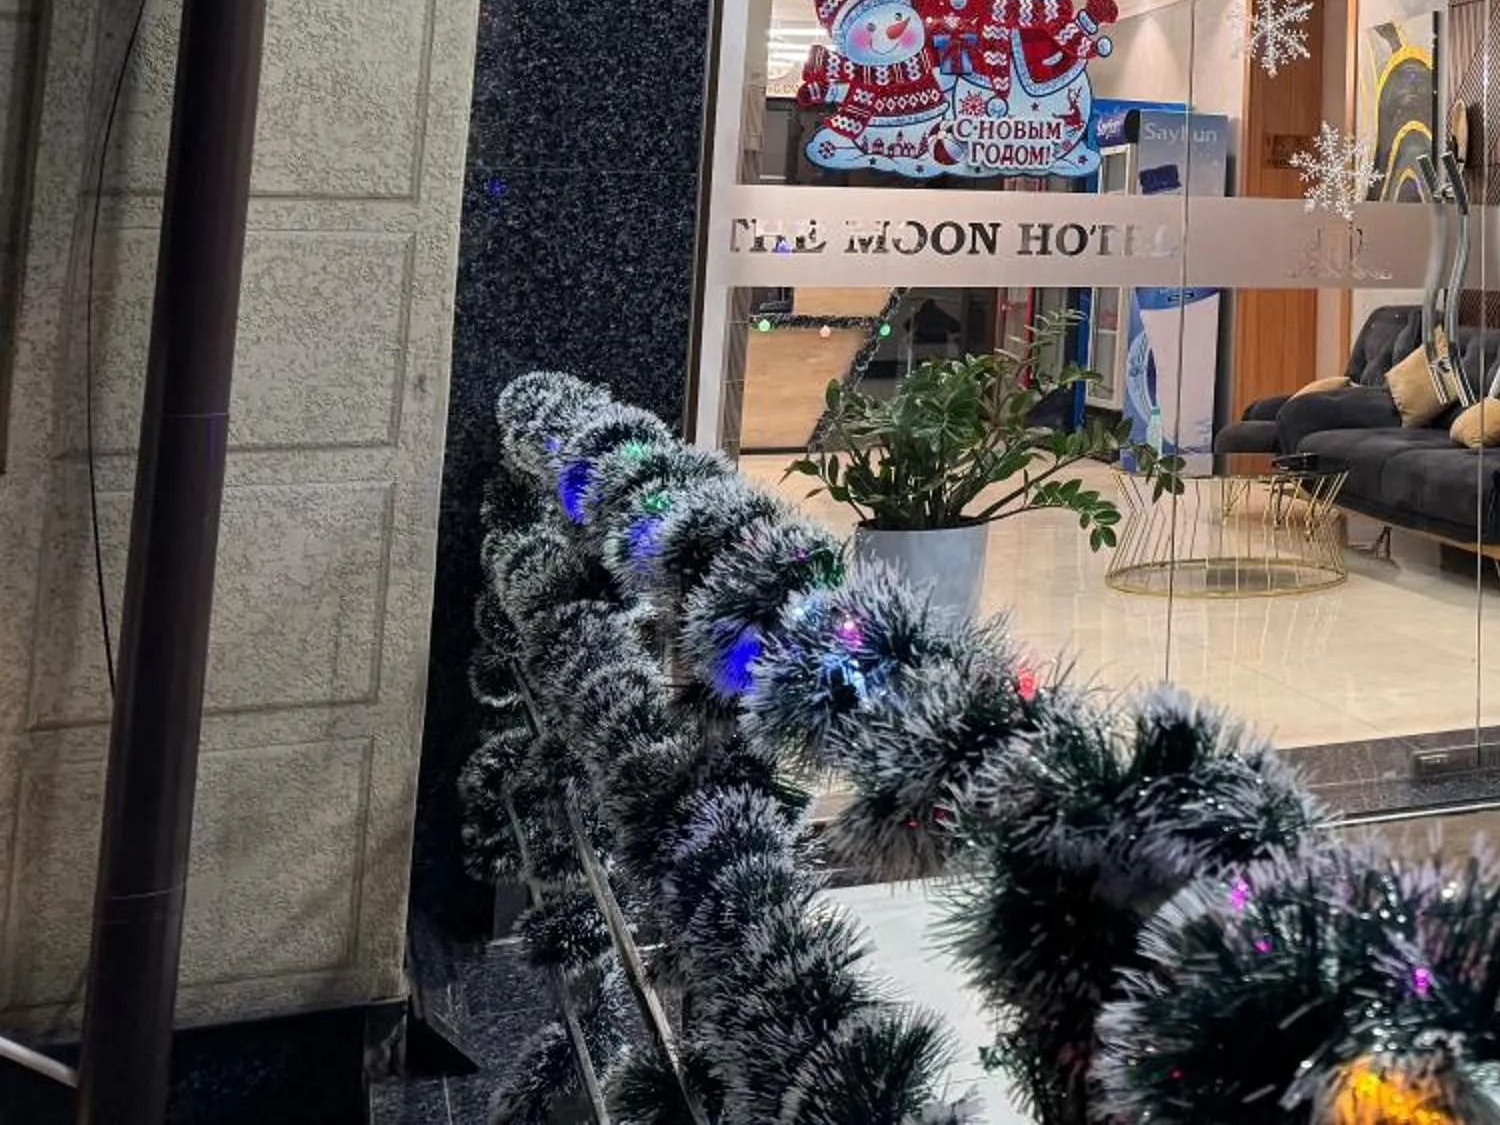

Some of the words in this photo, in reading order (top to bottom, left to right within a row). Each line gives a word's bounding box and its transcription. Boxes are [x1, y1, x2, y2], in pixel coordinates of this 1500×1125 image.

[956, 118, 973, 139] С
[977, 120, 1062, 140] НОВЫМ
[971, 141, 1051, 166] ГОДОМ!
[843, 219, 1002, 256] MOON
